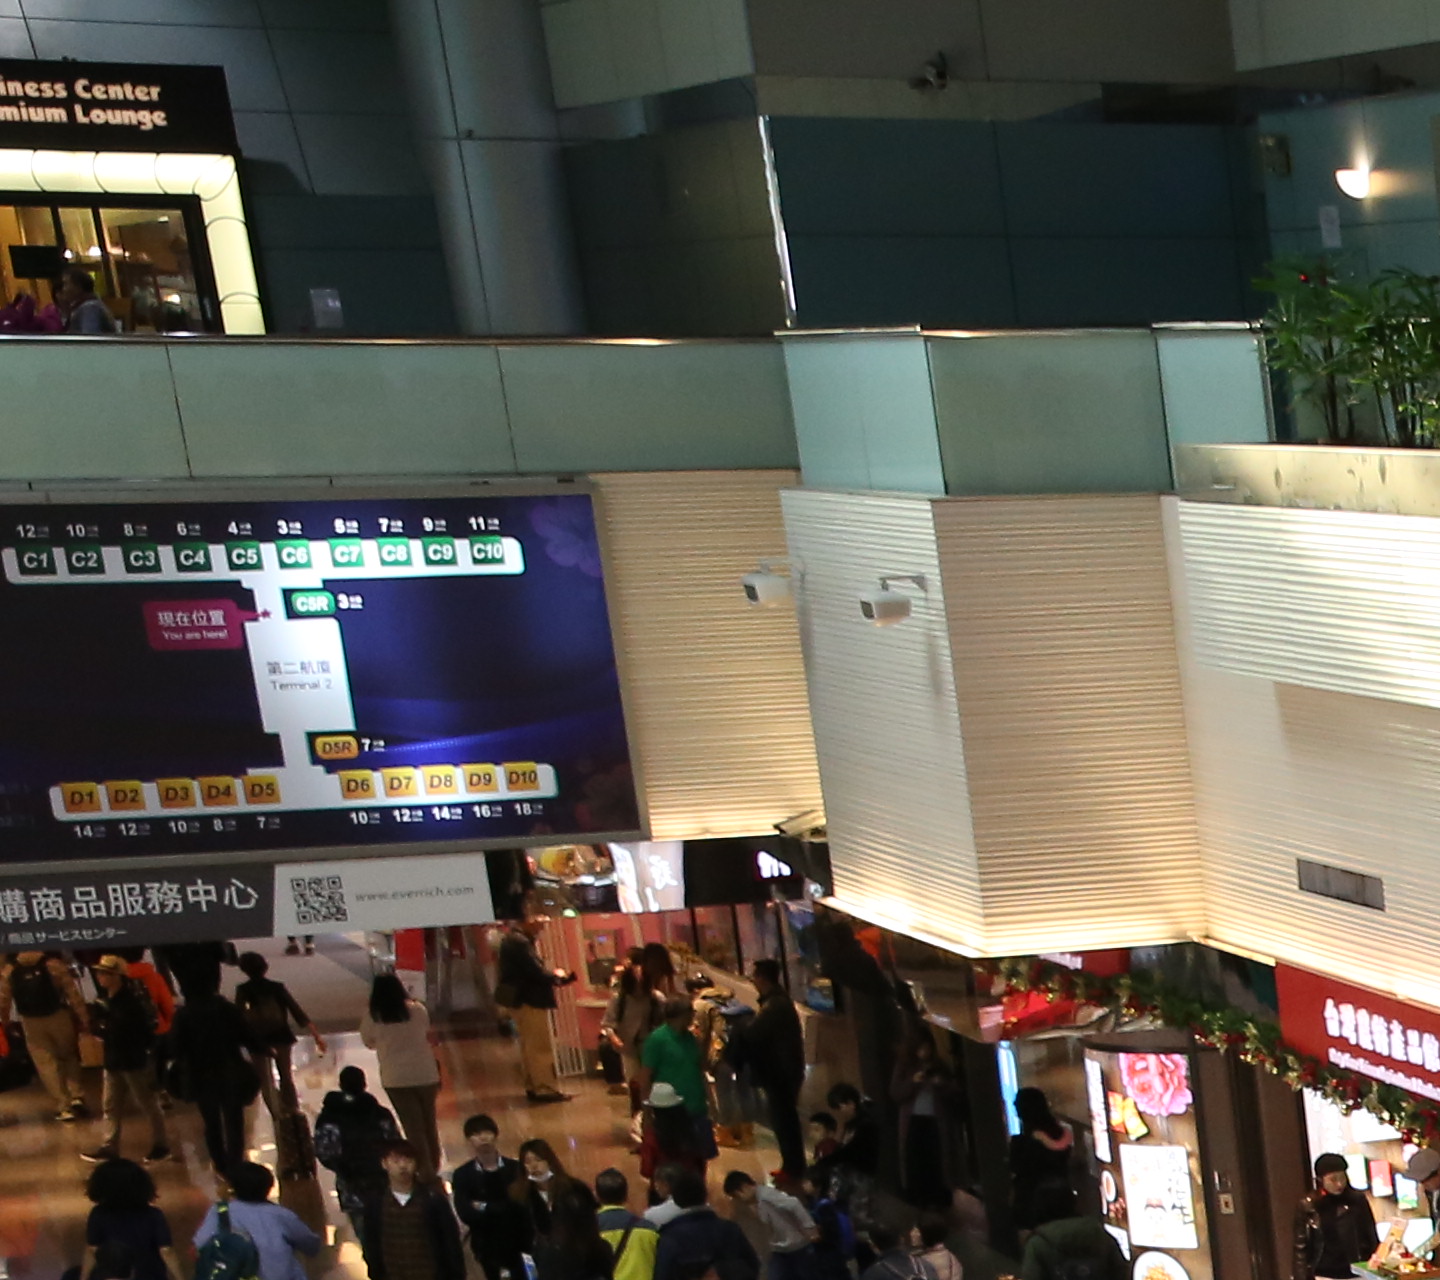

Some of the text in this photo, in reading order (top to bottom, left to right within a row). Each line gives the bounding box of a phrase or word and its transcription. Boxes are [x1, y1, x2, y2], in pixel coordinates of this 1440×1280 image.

[74, 78, 161, 101] Center
[74, 103, 167, 131] Lounge
[129, 550, 155, 567] C3
[179, 549, 206, 566] C4
[231, 548, 258, 565] C5
[281, 547, 308, 564] C6
[334, 545, 361, 563] C7
[380, 544, 408, 561] C8
[428, 544, 453, 560] C9
[472, 543, 503, 559] C10
[23, 551, 49, 569] C1
[71, 551, 98, 568] C2
[295, 596, 329, 612] C5R
[157, 610, 227, 627] 現在位置
[346, 779, 370, 793] D6
[389, 777, 412, 791] D7
[430, 775, 453, 788] D8
[469, 773, 492, 787] D9
[508, 771, 538, 785] D10
[70, 790, 94, 805] D1
[114, 789, 139, 803] D2
[165, 787, 189, 801] D3
[207, 785, 232, 799] D4
[250, 783, 275, 798] D5
